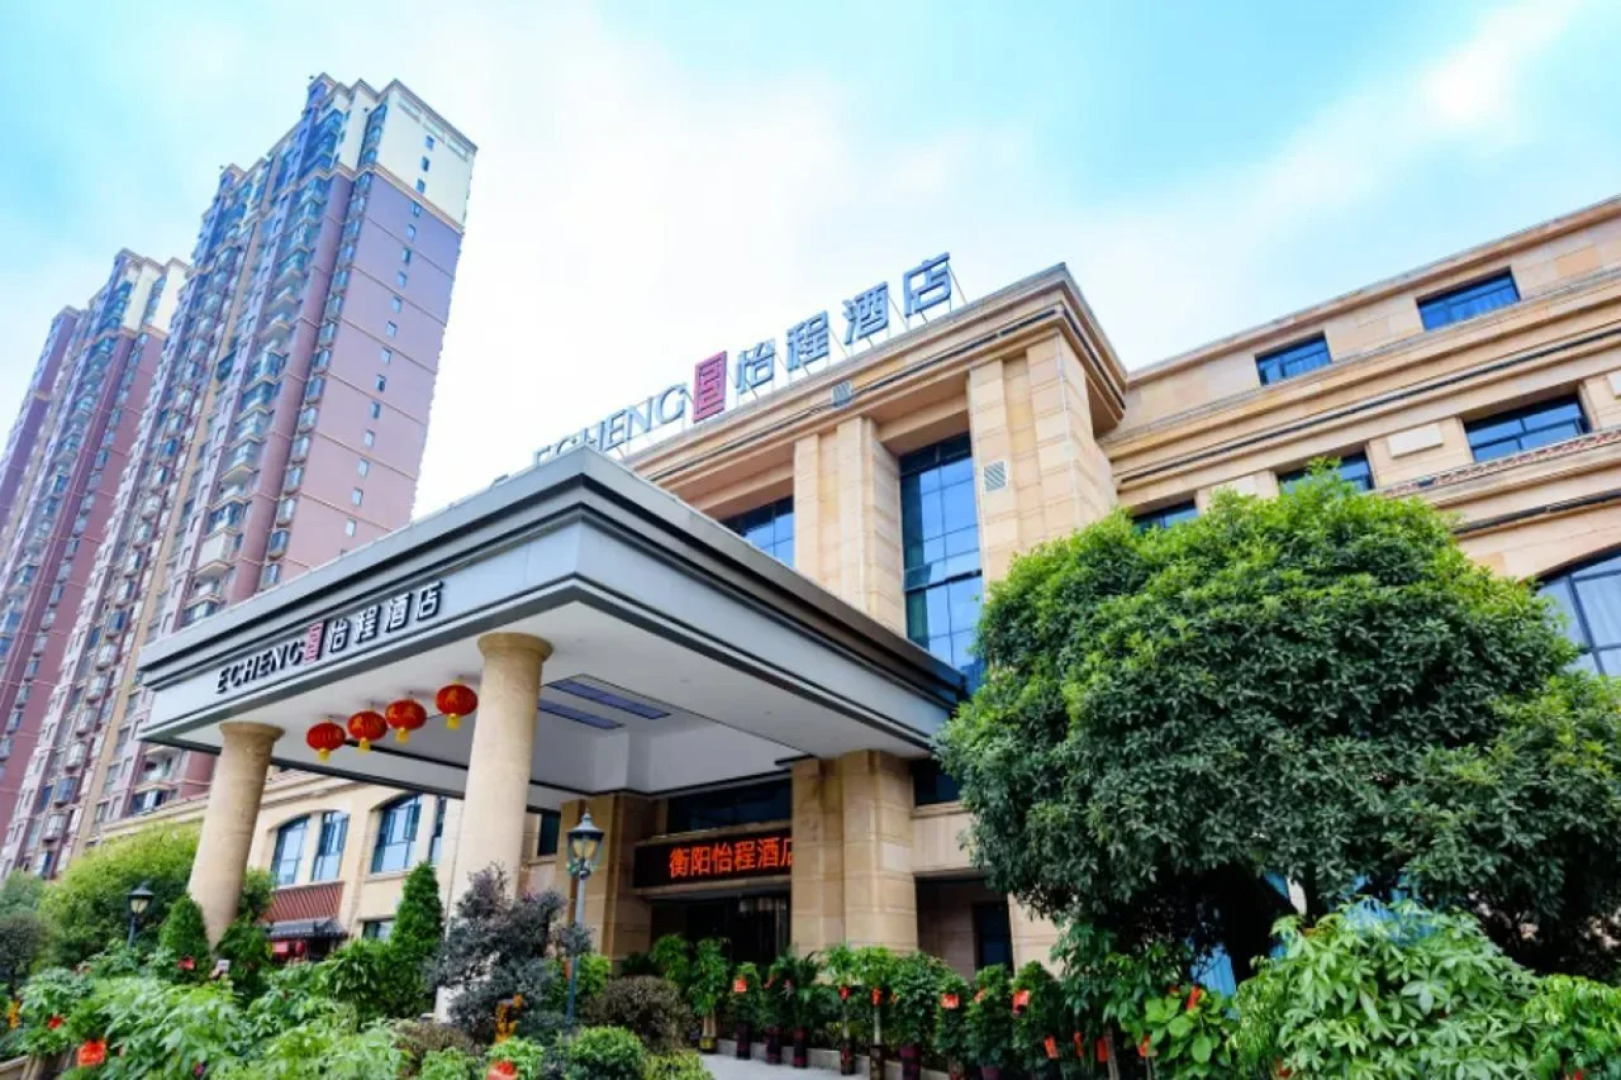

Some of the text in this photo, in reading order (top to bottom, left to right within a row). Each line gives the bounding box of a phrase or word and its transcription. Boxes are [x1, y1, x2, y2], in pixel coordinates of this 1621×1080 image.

[735, 252, 952, 394] 怡程酒店
[217, 580, 443, 693] ECHENG 怡程酒店
